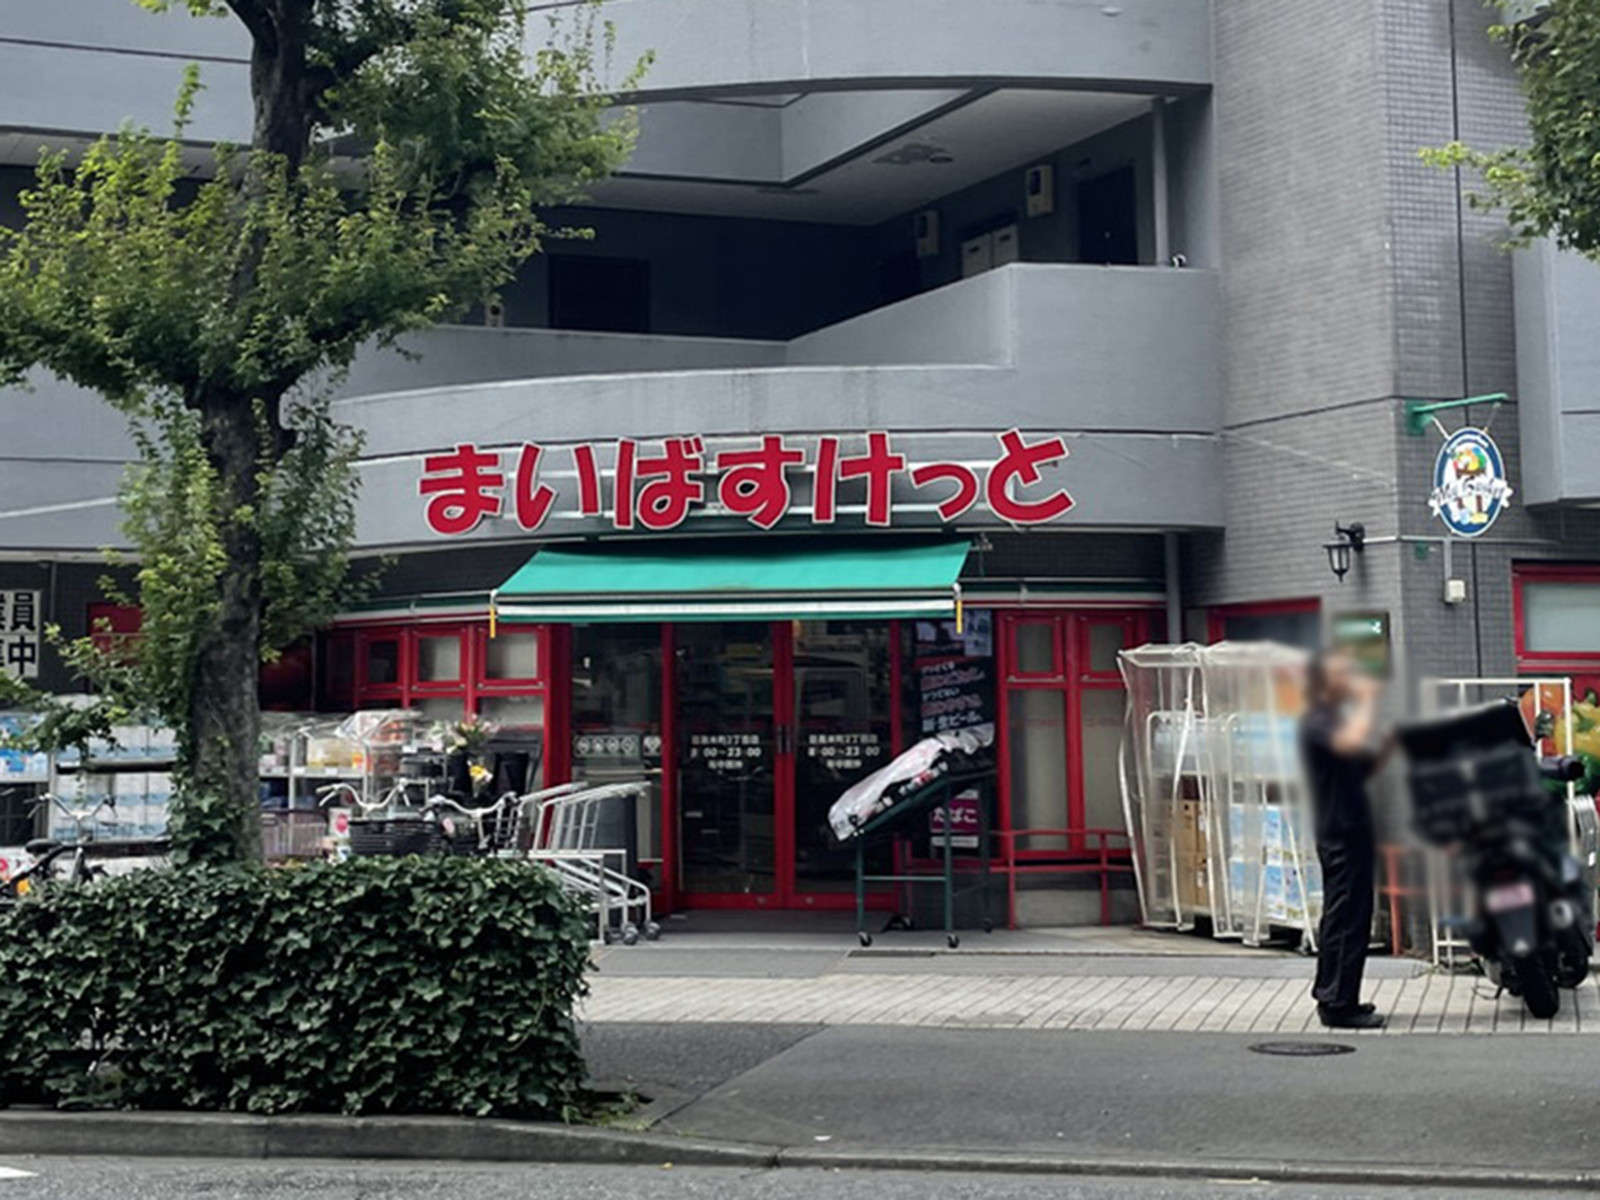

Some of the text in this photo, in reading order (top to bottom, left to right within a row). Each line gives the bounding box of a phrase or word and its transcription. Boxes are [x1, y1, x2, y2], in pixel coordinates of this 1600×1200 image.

[419, 428, 1075, 534] まいばすけっと
[0, 592, 35, 632] 員
[0, 636, 35, 676] 中
[933, 807, 977, 823] たばこ
